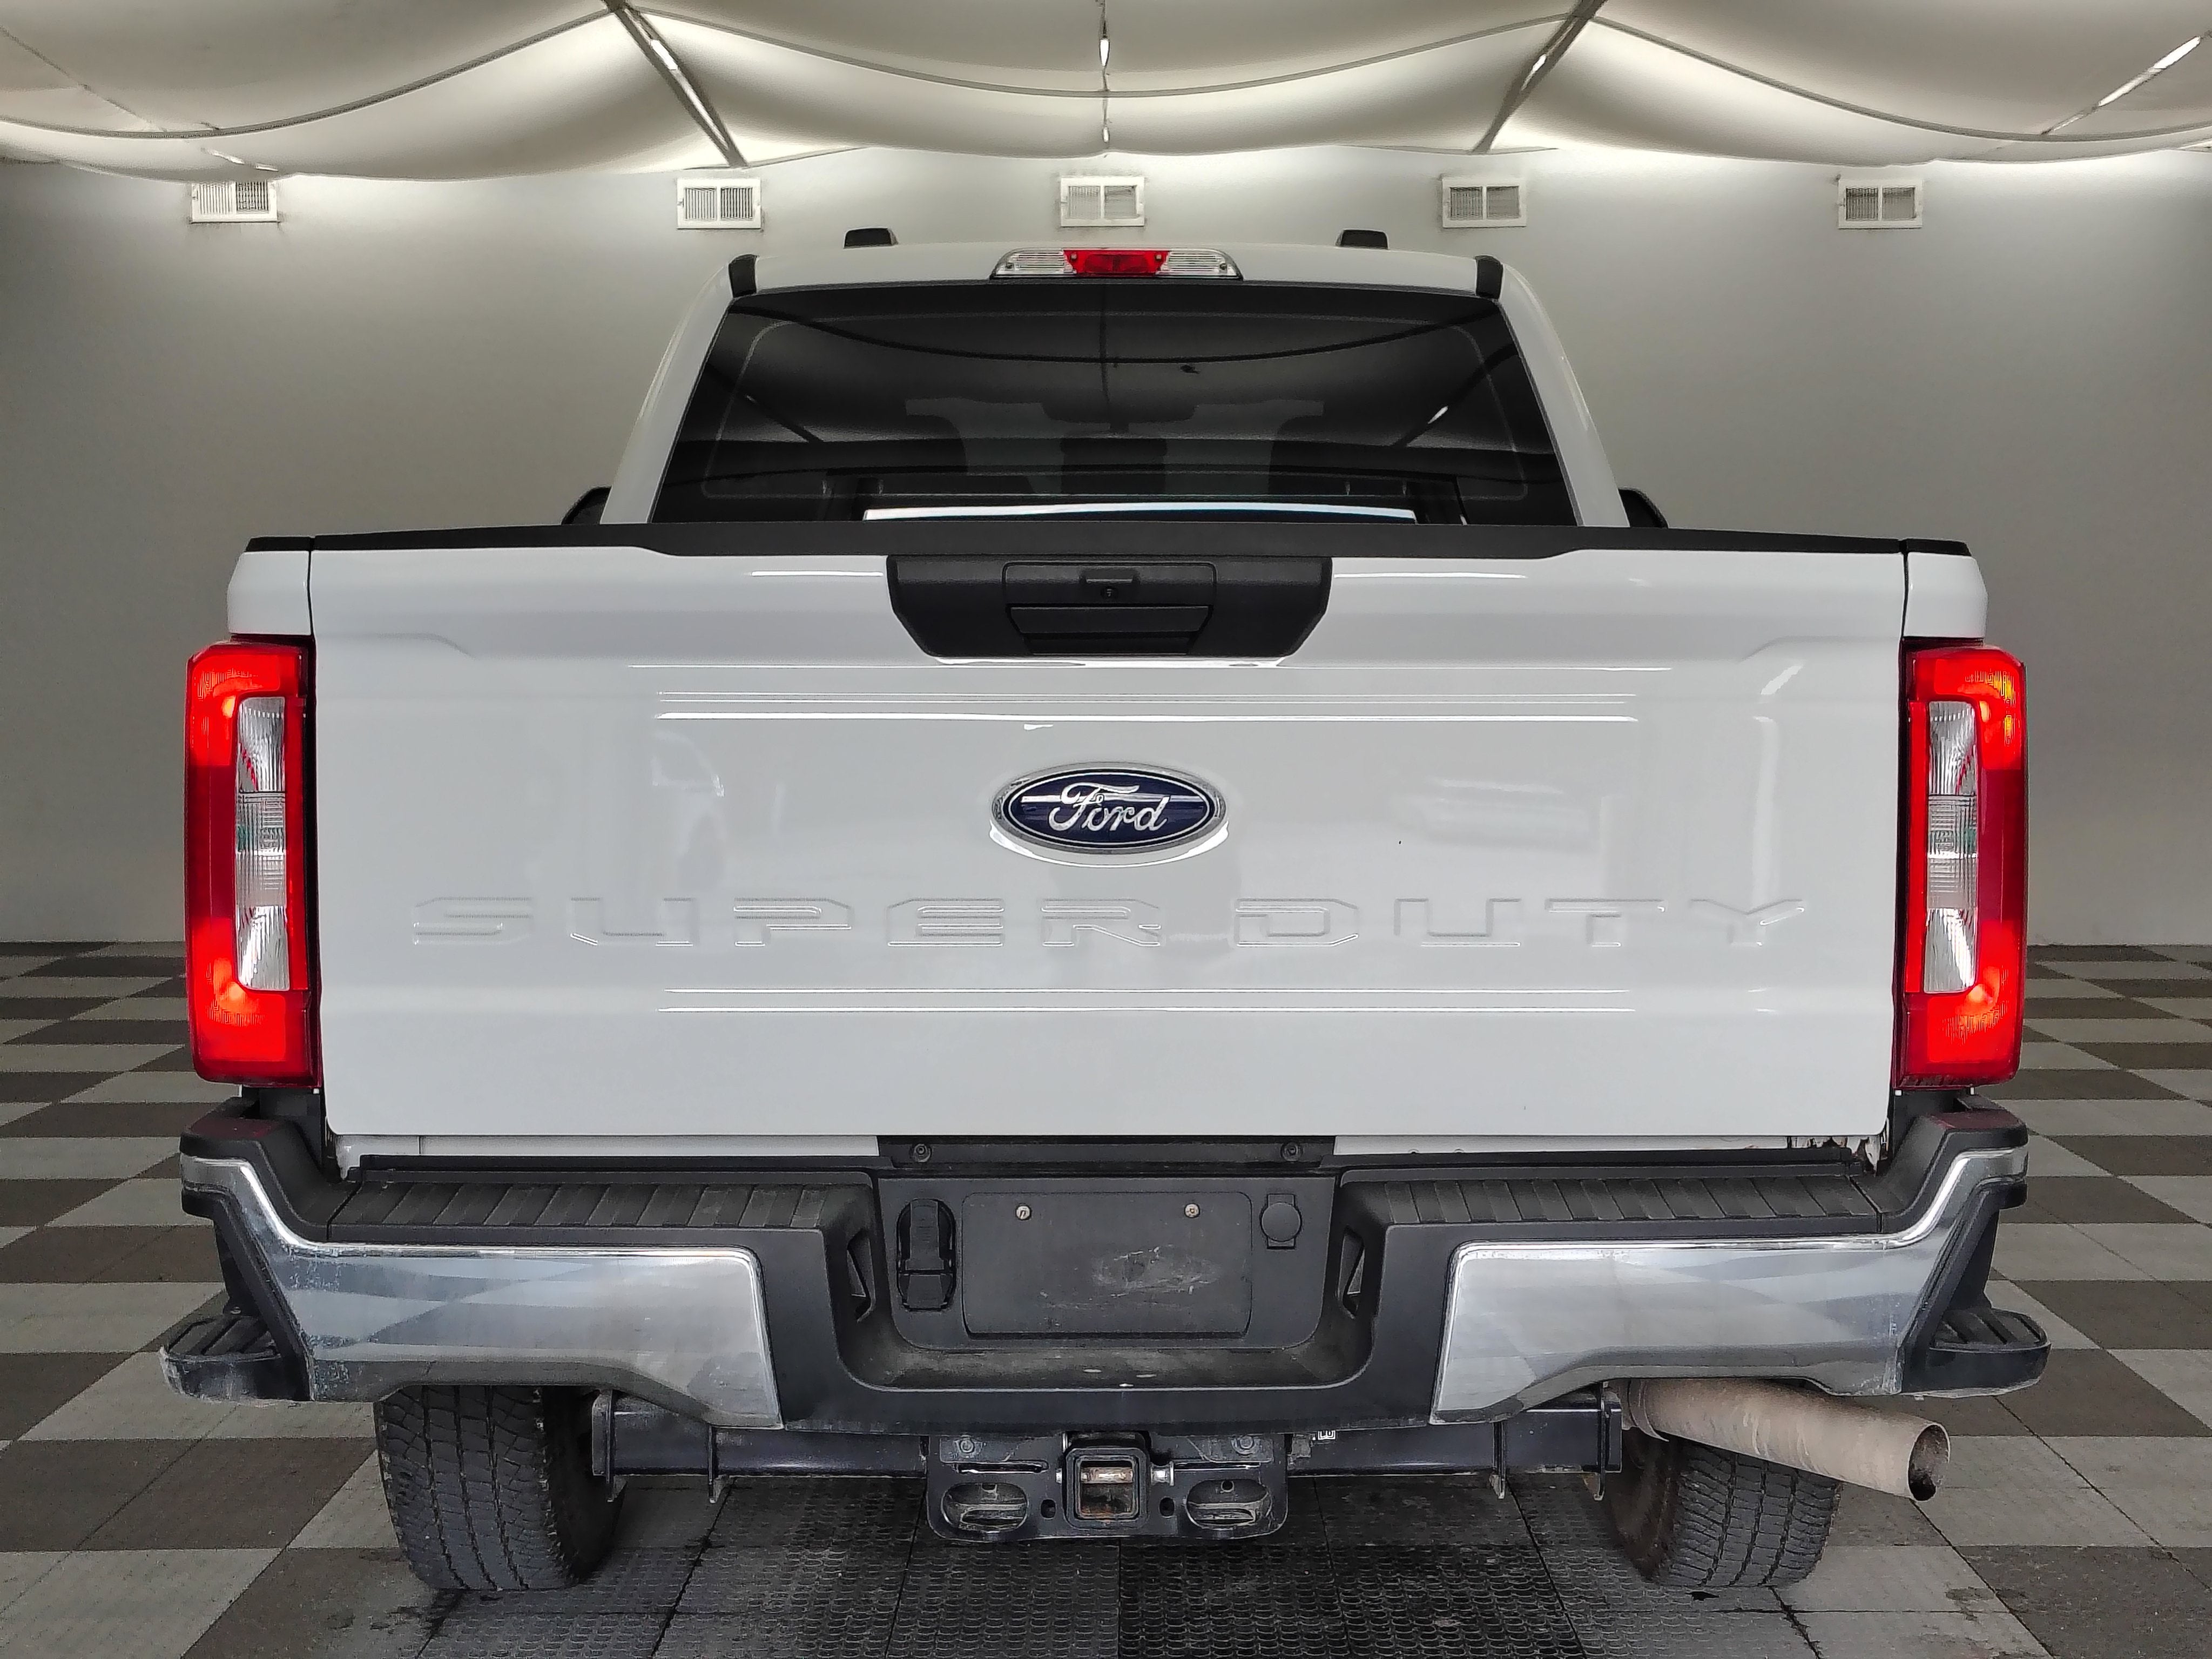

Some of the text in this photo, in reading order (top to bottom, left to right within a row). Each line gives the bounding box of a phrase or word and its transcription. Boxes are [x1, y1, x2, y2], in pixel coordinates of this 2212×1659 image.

[1049, 782, 1170, 832] Ford
[412, 896, 1805, 948] SUPER DUTY
